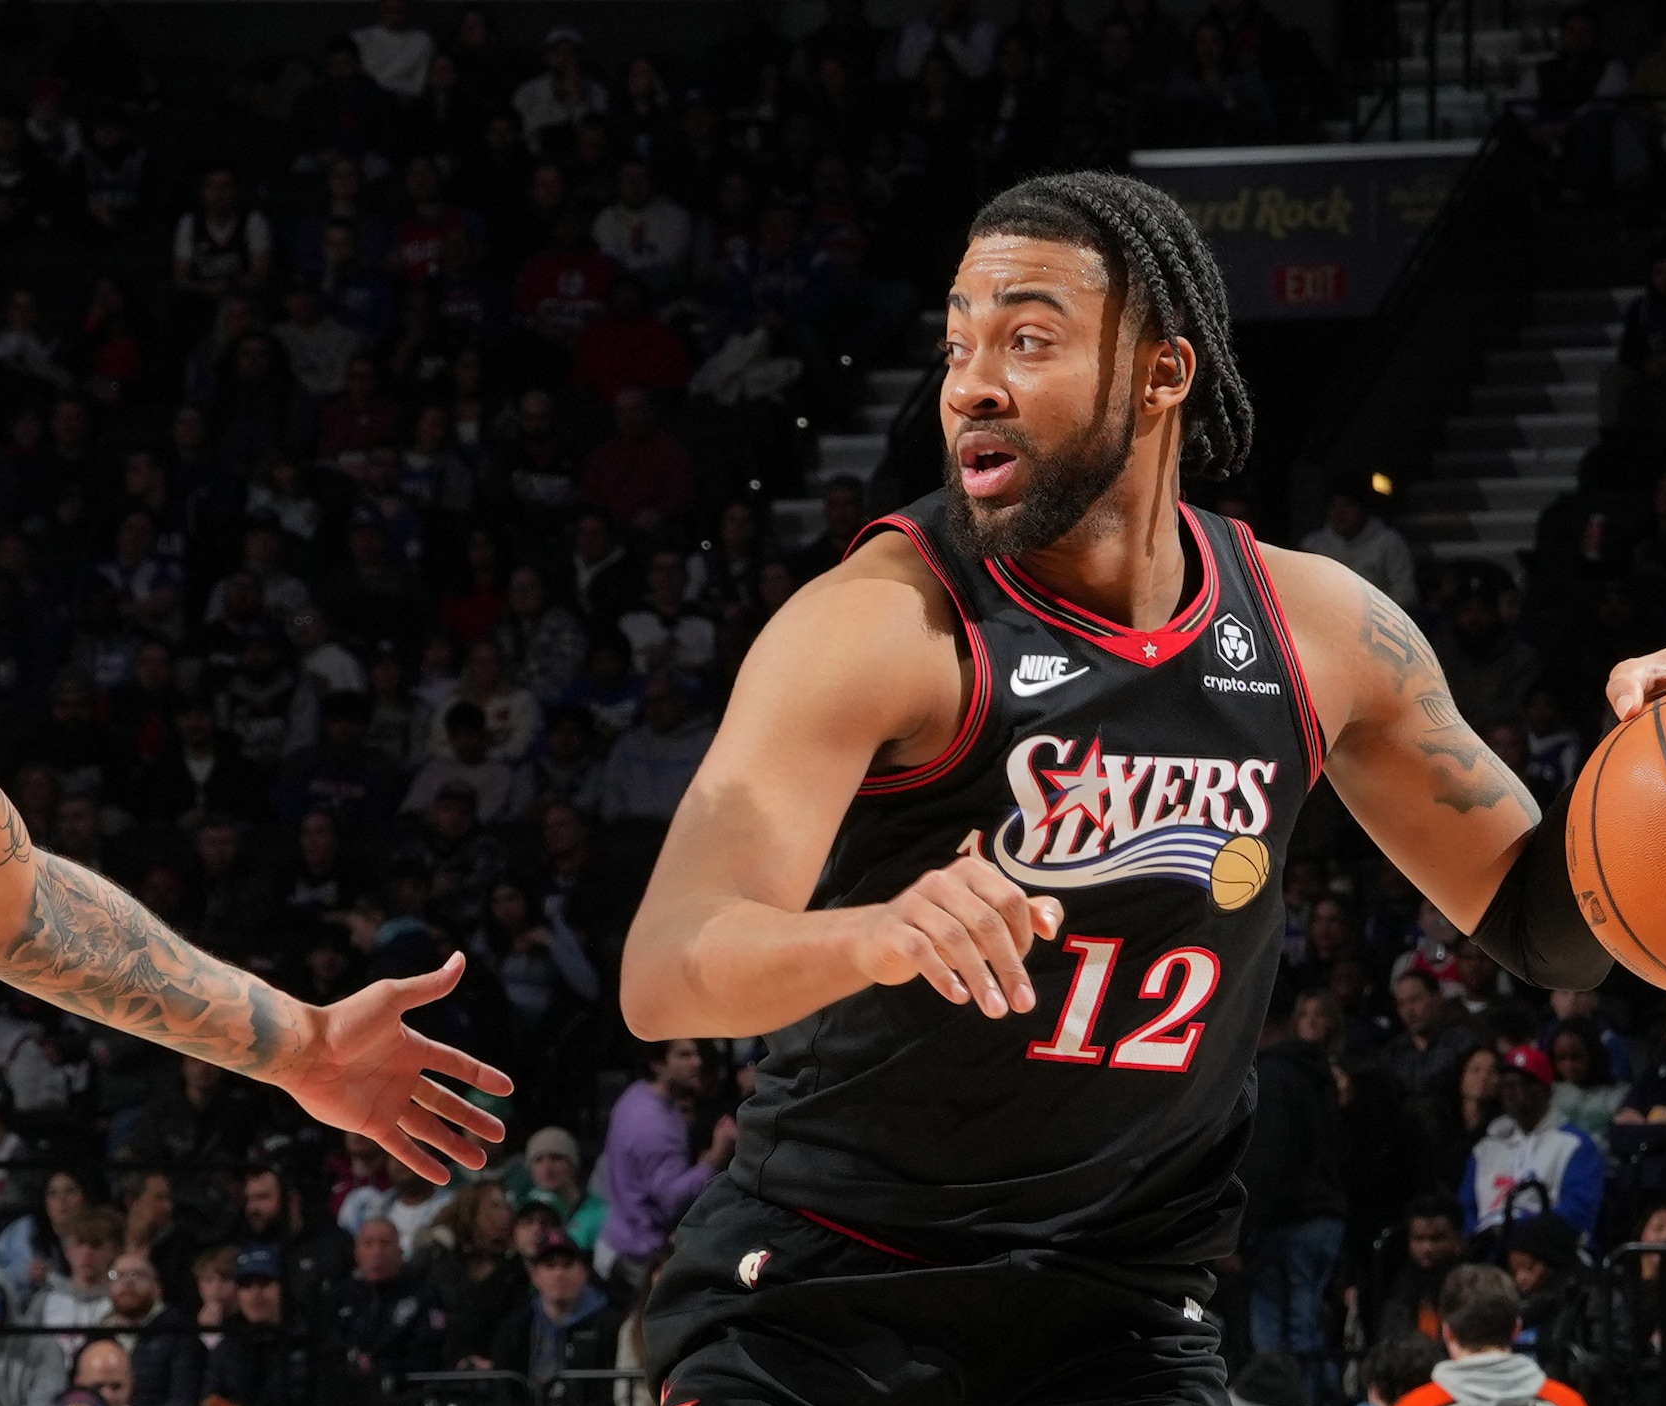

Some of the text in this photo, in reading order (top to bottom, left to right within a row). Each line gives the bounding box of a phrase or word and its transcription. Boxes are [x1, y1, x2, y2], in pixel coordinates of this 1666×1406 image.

[1254, 186, 1354, 240] Rock
[1284, 263, 1339, 303] EXIT
[1019, 654, 1069, 681] NIKE
[1203, 674, 1281, 696] crypto.com
[1025, 933, 1222, 1073] 12
